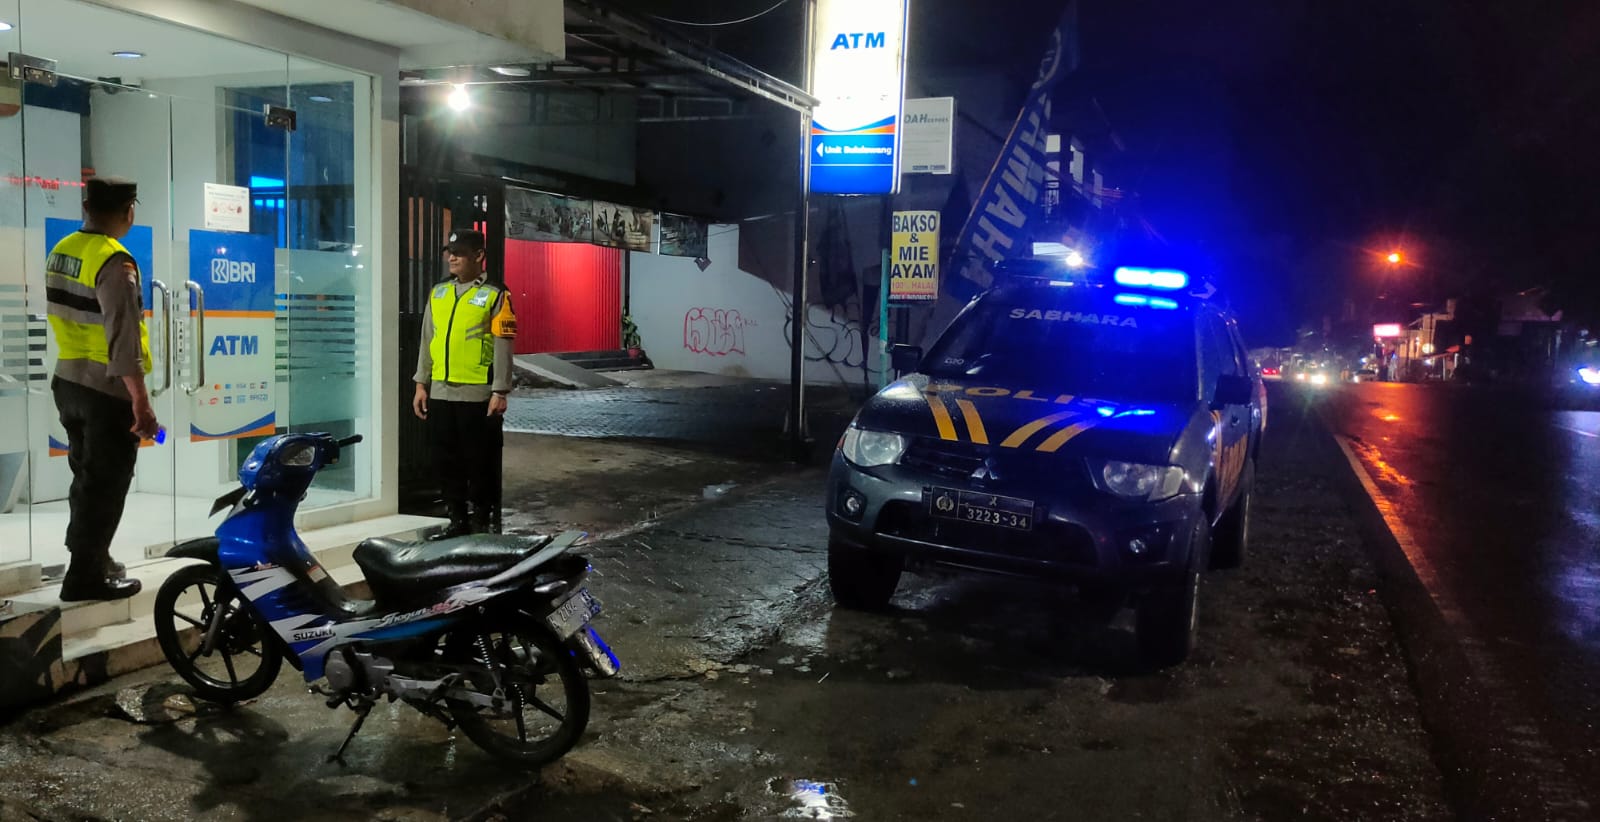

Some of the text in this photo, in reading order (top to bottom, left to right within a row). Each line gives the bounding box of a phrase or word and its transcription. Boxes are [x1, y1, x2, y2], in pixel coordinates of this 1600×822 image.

[830, 32, 885, 50] ATM
[893, 214, 937, 232] BAKSO
[909, 232, 919, 243] &
[899, 246, 928, 261] MIE
[229, 260, 256, 283] BRI
[891, 263, 935, 279] AYAM
[1009, 308, 1138, 329] SABHARA
[209, 335, 258, 356] ATM
[967, 508, 1027, 528] 3223-34
[293, 629, 332, 641] SUZUKI
